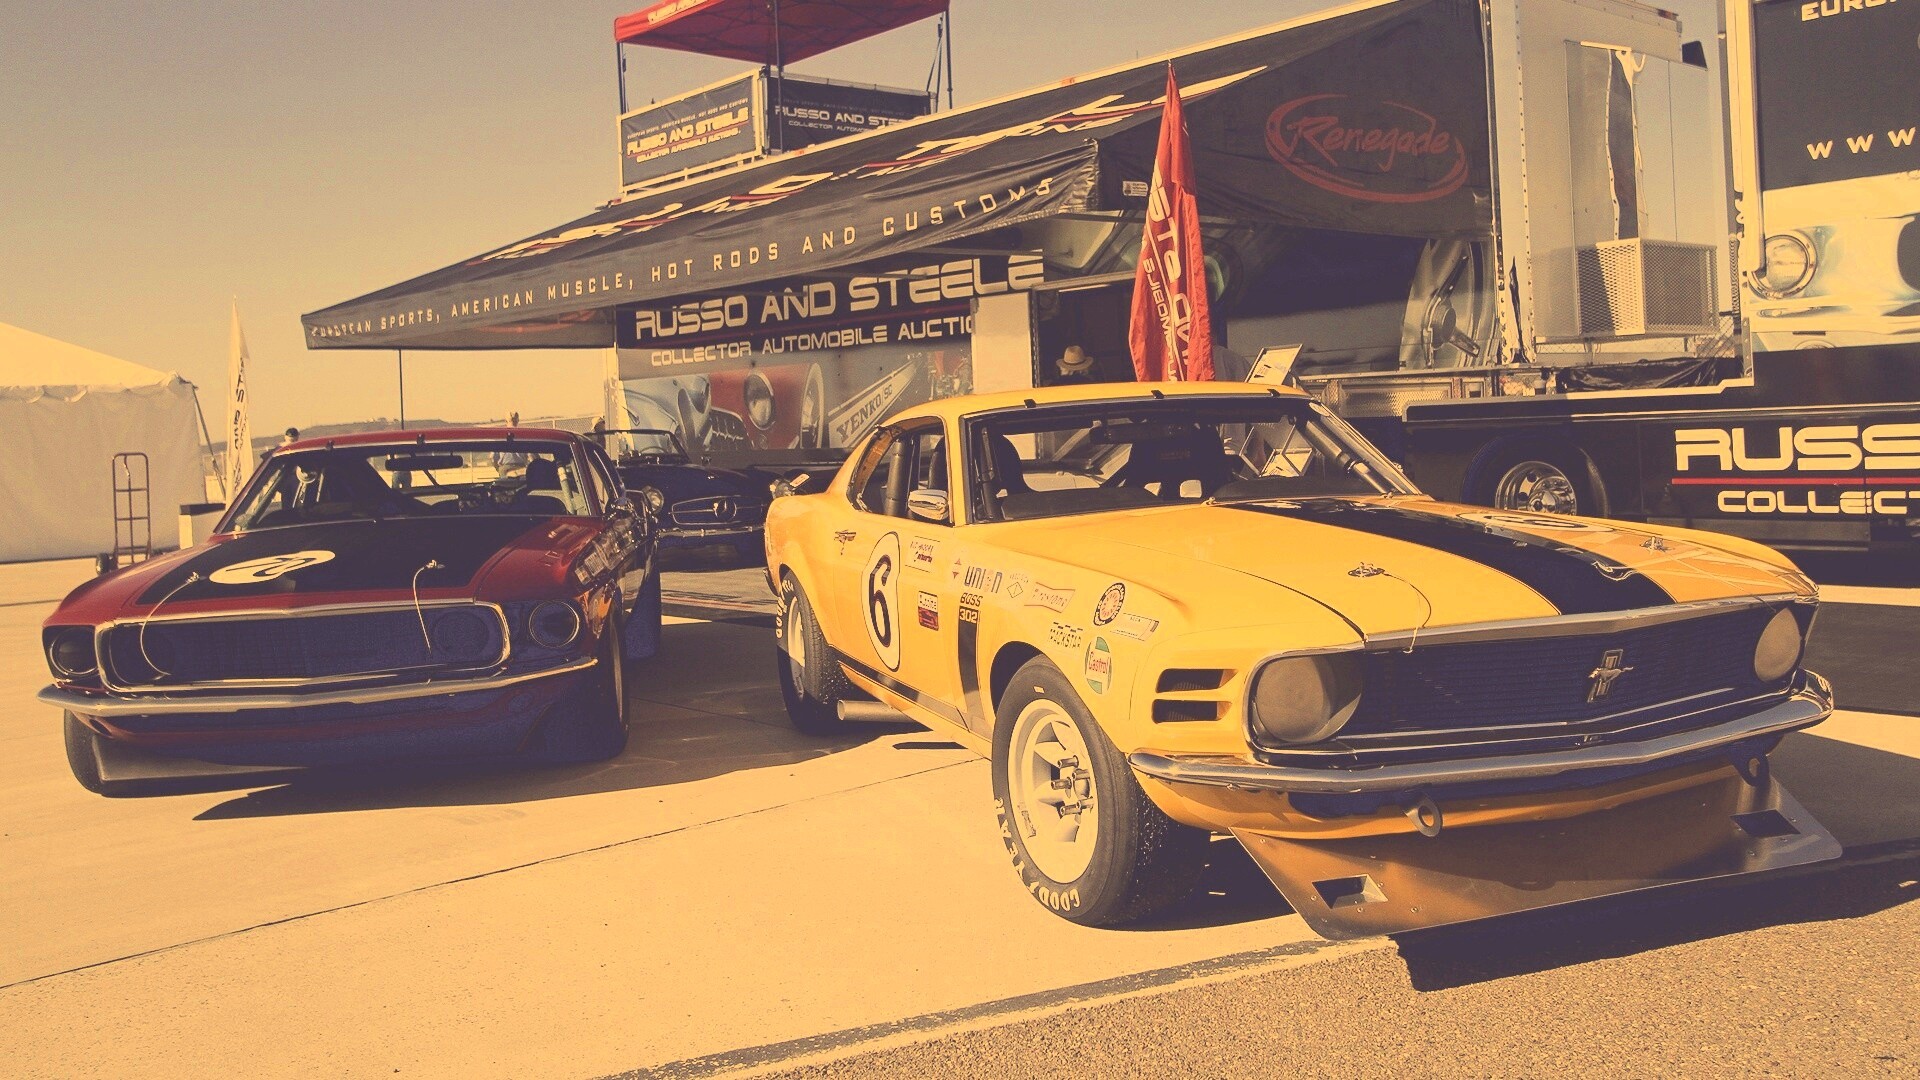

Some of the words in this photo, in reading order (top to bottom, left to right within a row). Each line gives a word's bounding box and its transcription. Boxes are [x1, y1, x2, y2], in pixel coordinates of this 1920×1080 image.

[670, 124, 694, 143] AND
[775, 105, 830, 121] RUSSO
[835, 112, 864, 124] AND
[1287, 114, 1450, 173] Renegade
[381, 308, 440, 330] SPORTS,
[451, 290, 534, 317] AMERICAN
[547, 272, 633, 300] MUSCLE,
[651, 259, 693, 282] HOT
[713, 242, 778, 271] RODS
[802, 227, 856, 254] AND
[882, 178, 1053, 236] CUSTOMS
[636, 295, 748, 340] RUSSO
[761, 281, 836, 325] AND
[849, 249, 1044, 312] STEELE
[651, 341, 752, 368] COLLECTOR
[762, 325, 887, 355] AUTOMOBILE
[869, 554, 891, 648] 6
[959, 608, 978, 624] 302
[960, 592, 984, 607] BOSS
